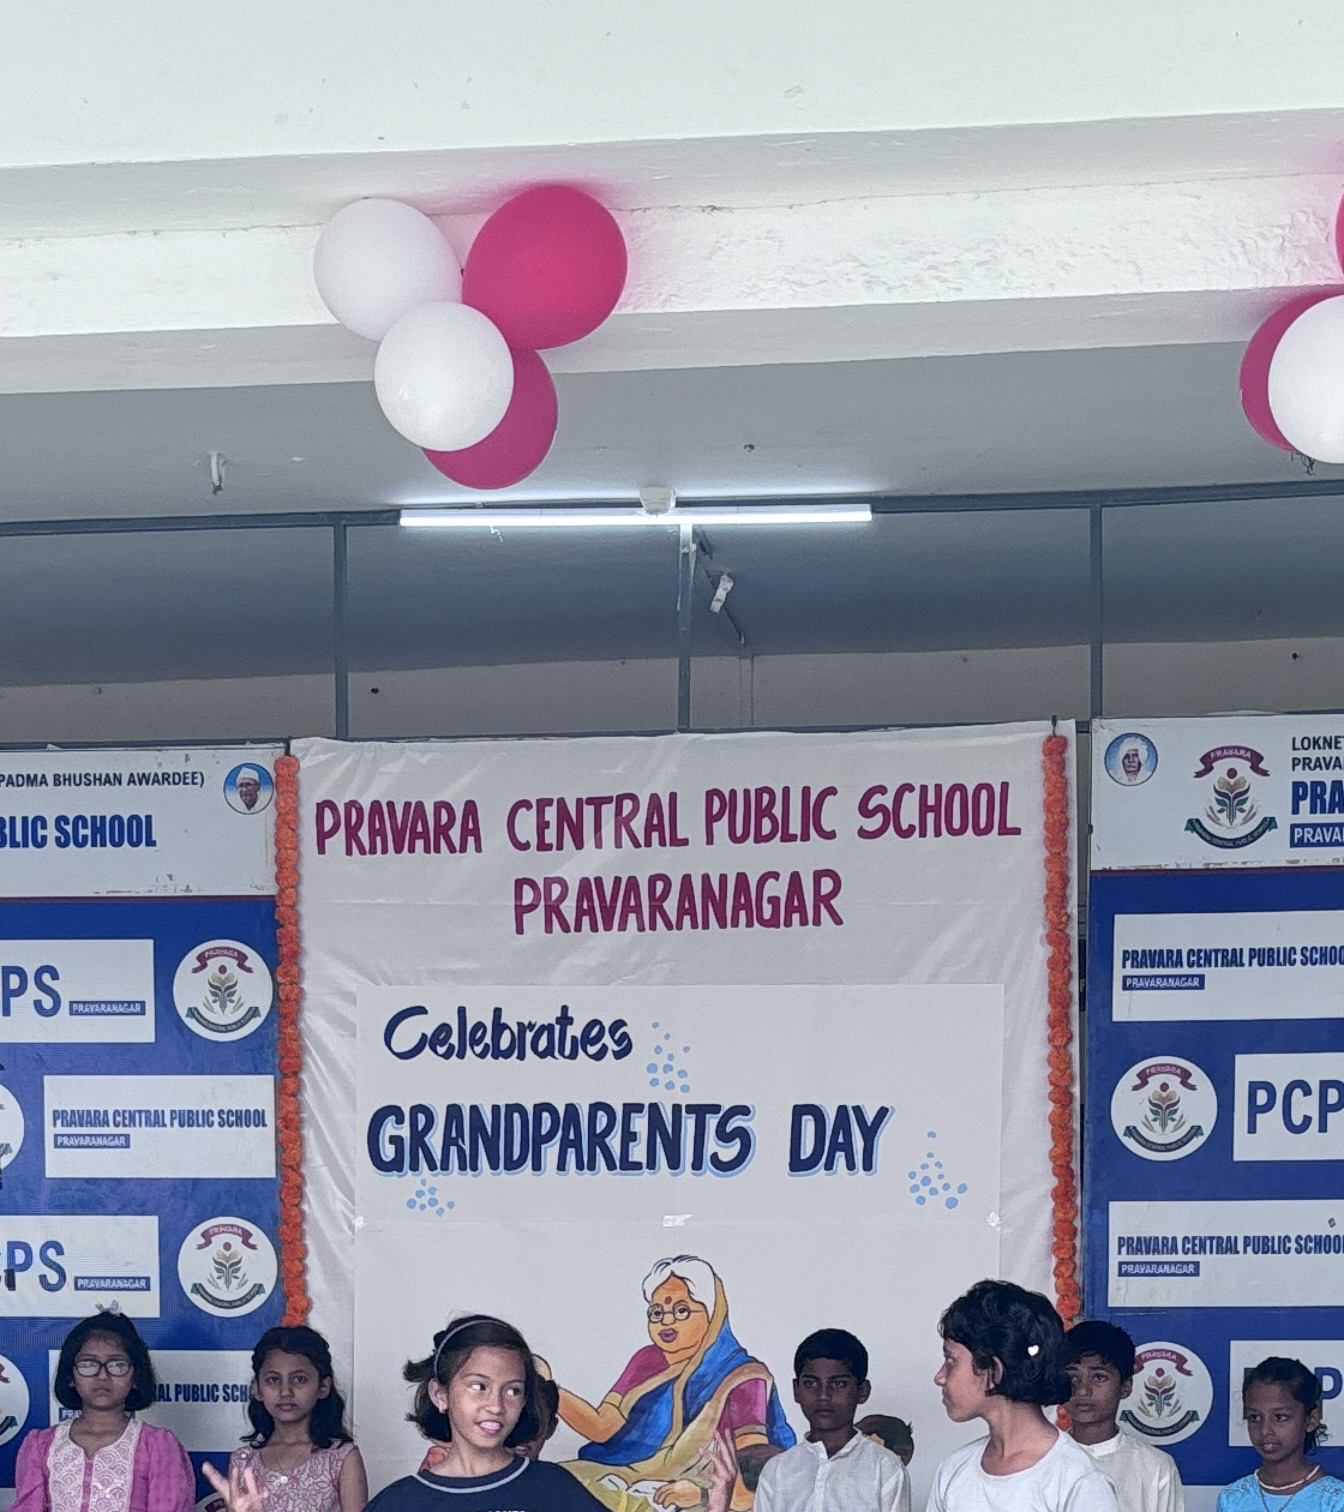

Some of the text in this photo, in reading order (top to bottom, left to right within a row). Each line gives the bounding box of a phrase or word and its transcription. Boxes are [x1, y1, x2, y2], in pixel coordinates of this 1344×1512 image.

[53, 772, 123, 787] BHUSHAN
[127, 771, 205, 788] AWARDEE)
[316, 781, 1021, 856] PRAVARA CENTRAL PUBLIC SCHOOL
[54, 814, 157, 848] SCHOOL
[514, 868, 844, 936] PRAVARANAGAR
[1121, 949, 1183, 969] PRAVARA
[1186, 948, 1246, 968] CENTRAL
[1248, 947, 1297, 967] PUBLIC
[1126, 977, 1200, 988] PRAVARANAGAR
[383, 1004, 633, 1061] Celebrates
[52, 1108, 267, 1128] PRAVARA CENTRAL PUBLIC SCHOOL
[367, 1101, 894, 1178] GRANDPARENTS DAY
[1117, 1236, 1179, 1256] PRAVARA
[1182, 1235, 1240, 1255] CENTRAL
[1243, 1235, 1292, 1255] PUBLIC
[1122, 1263, 1195, 1275] PRAVARANAGAR
[174, 1384, 219, 1402] PUBLIC
